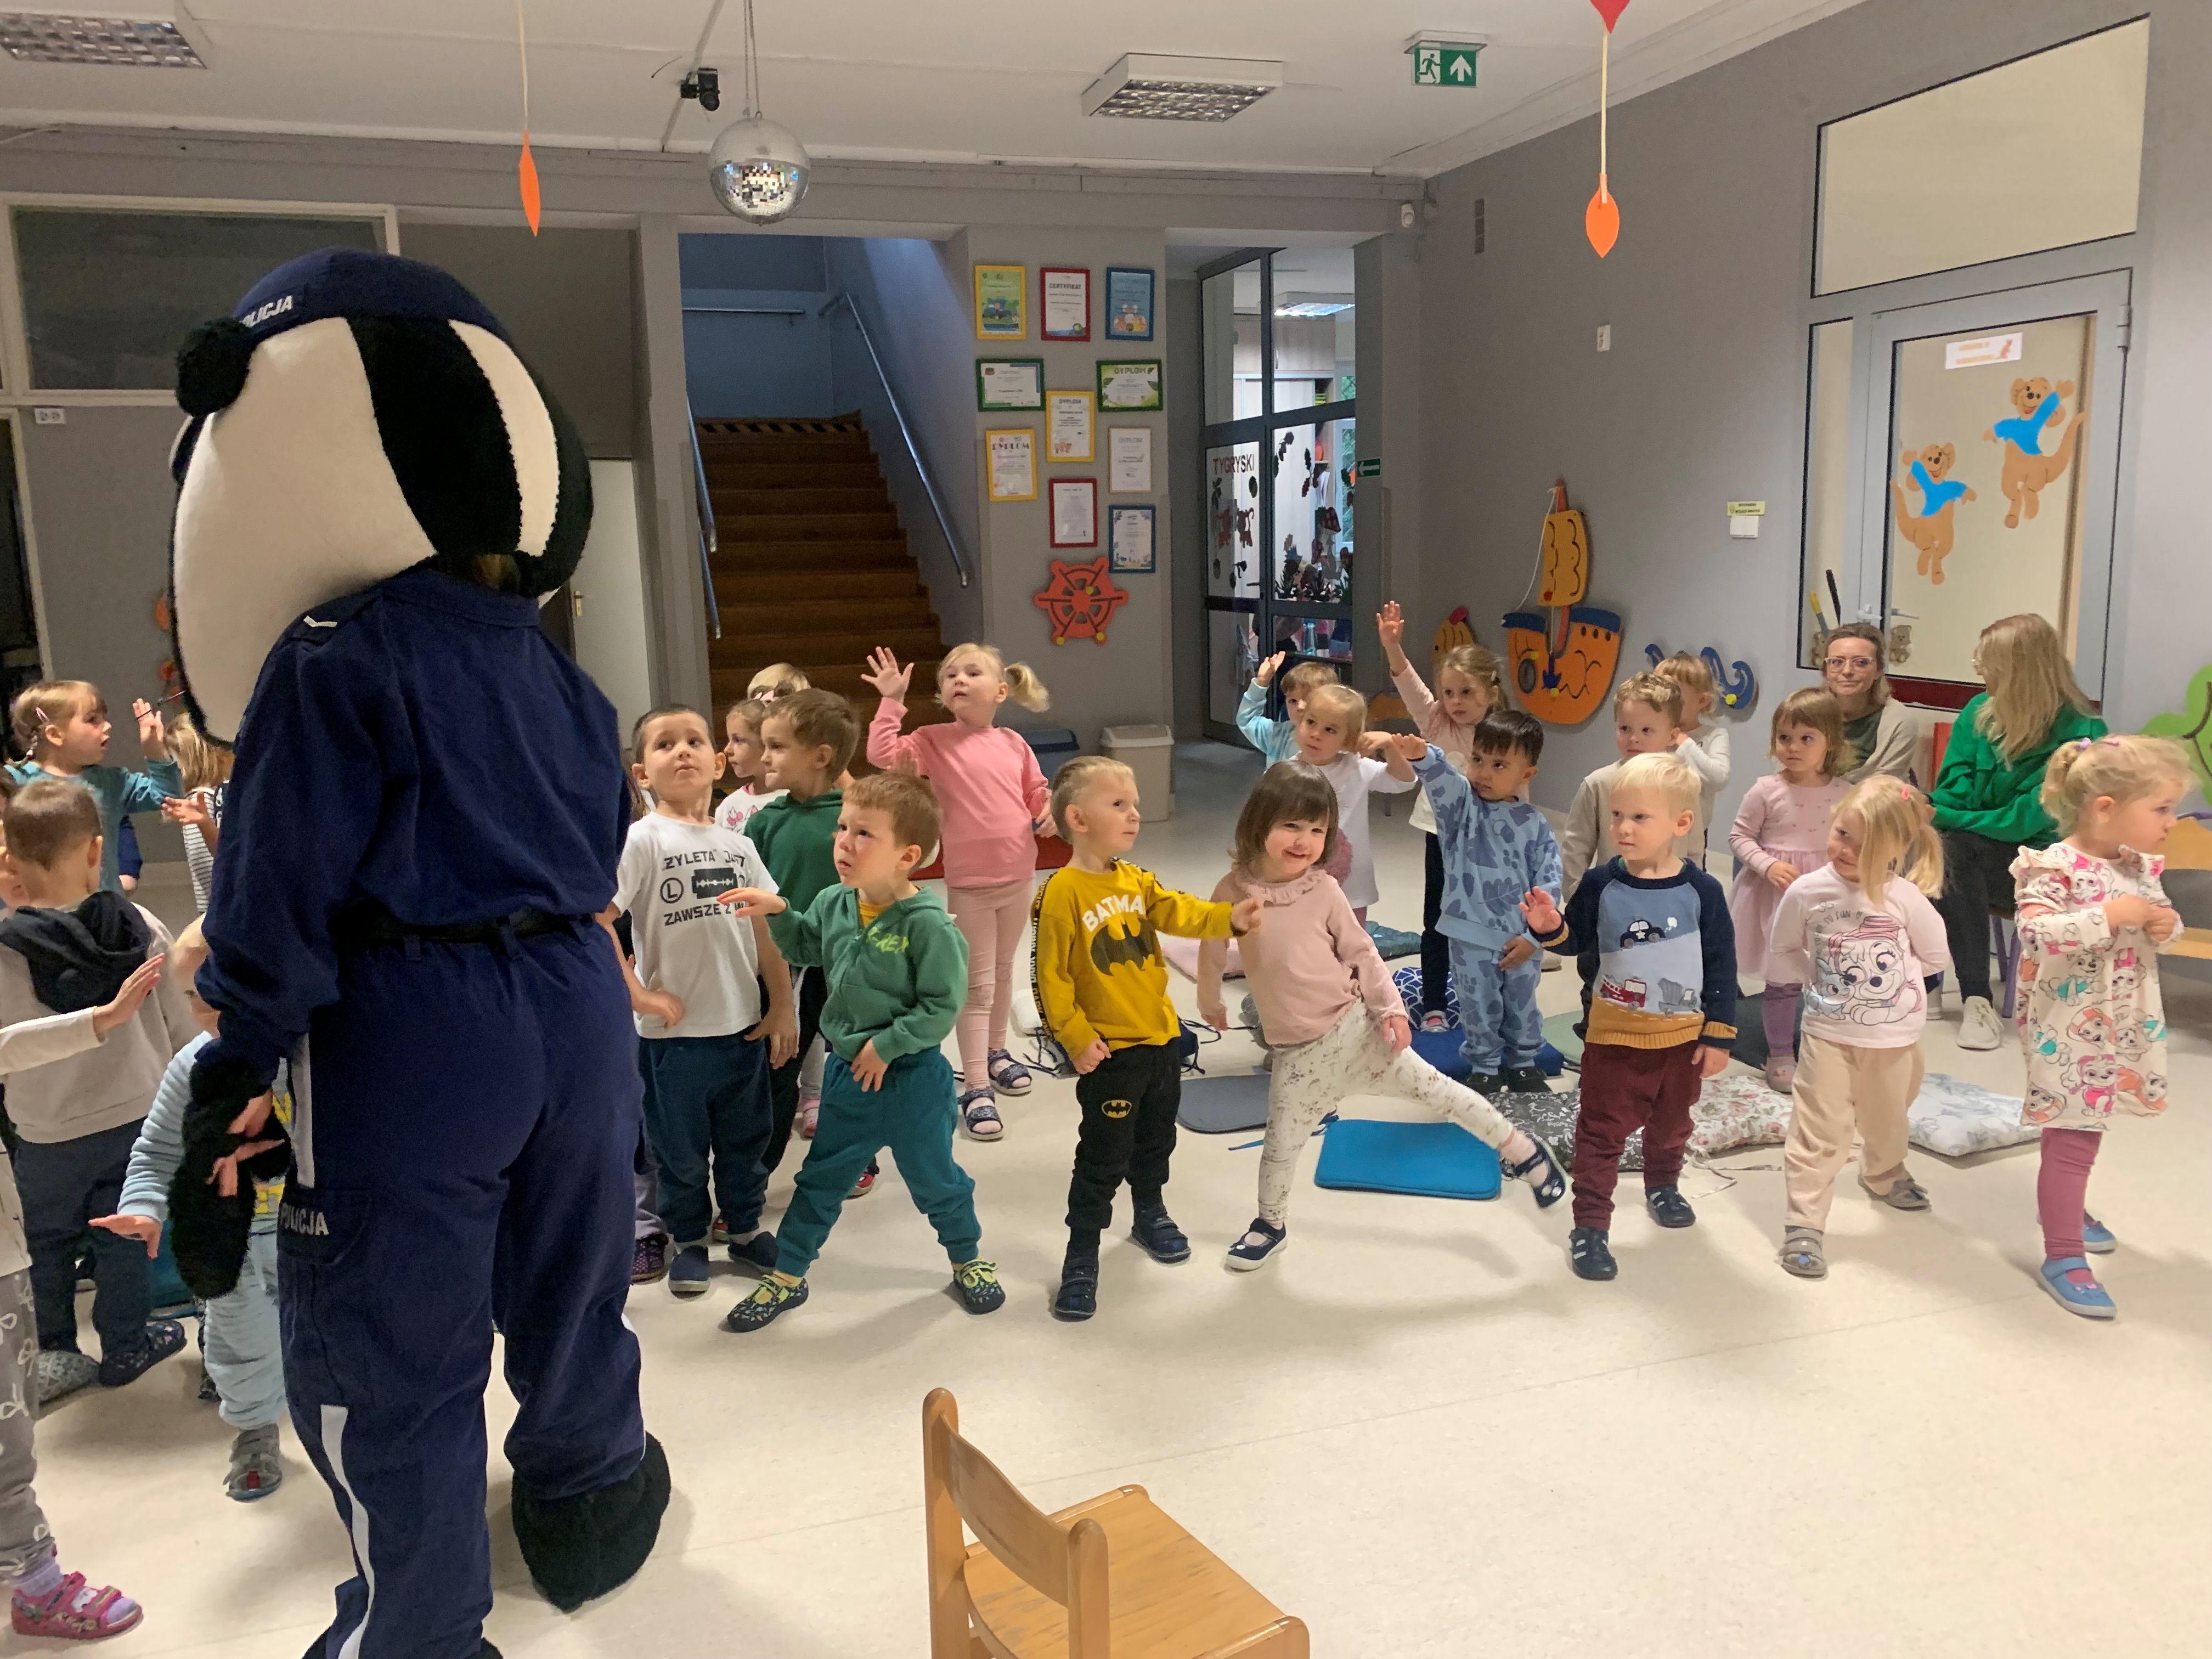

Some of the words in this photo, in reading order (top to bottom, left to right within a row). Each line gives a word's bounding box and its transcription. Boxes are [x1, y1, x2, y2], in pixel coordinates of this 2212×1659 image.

[242, 295, 293, 328] LICJA
[1212, 454, 1255, 475] TYGRYSKI
[663, 903, 722, 926] ZAWSZE
[1082, 894, 1146, 932] BATMA
